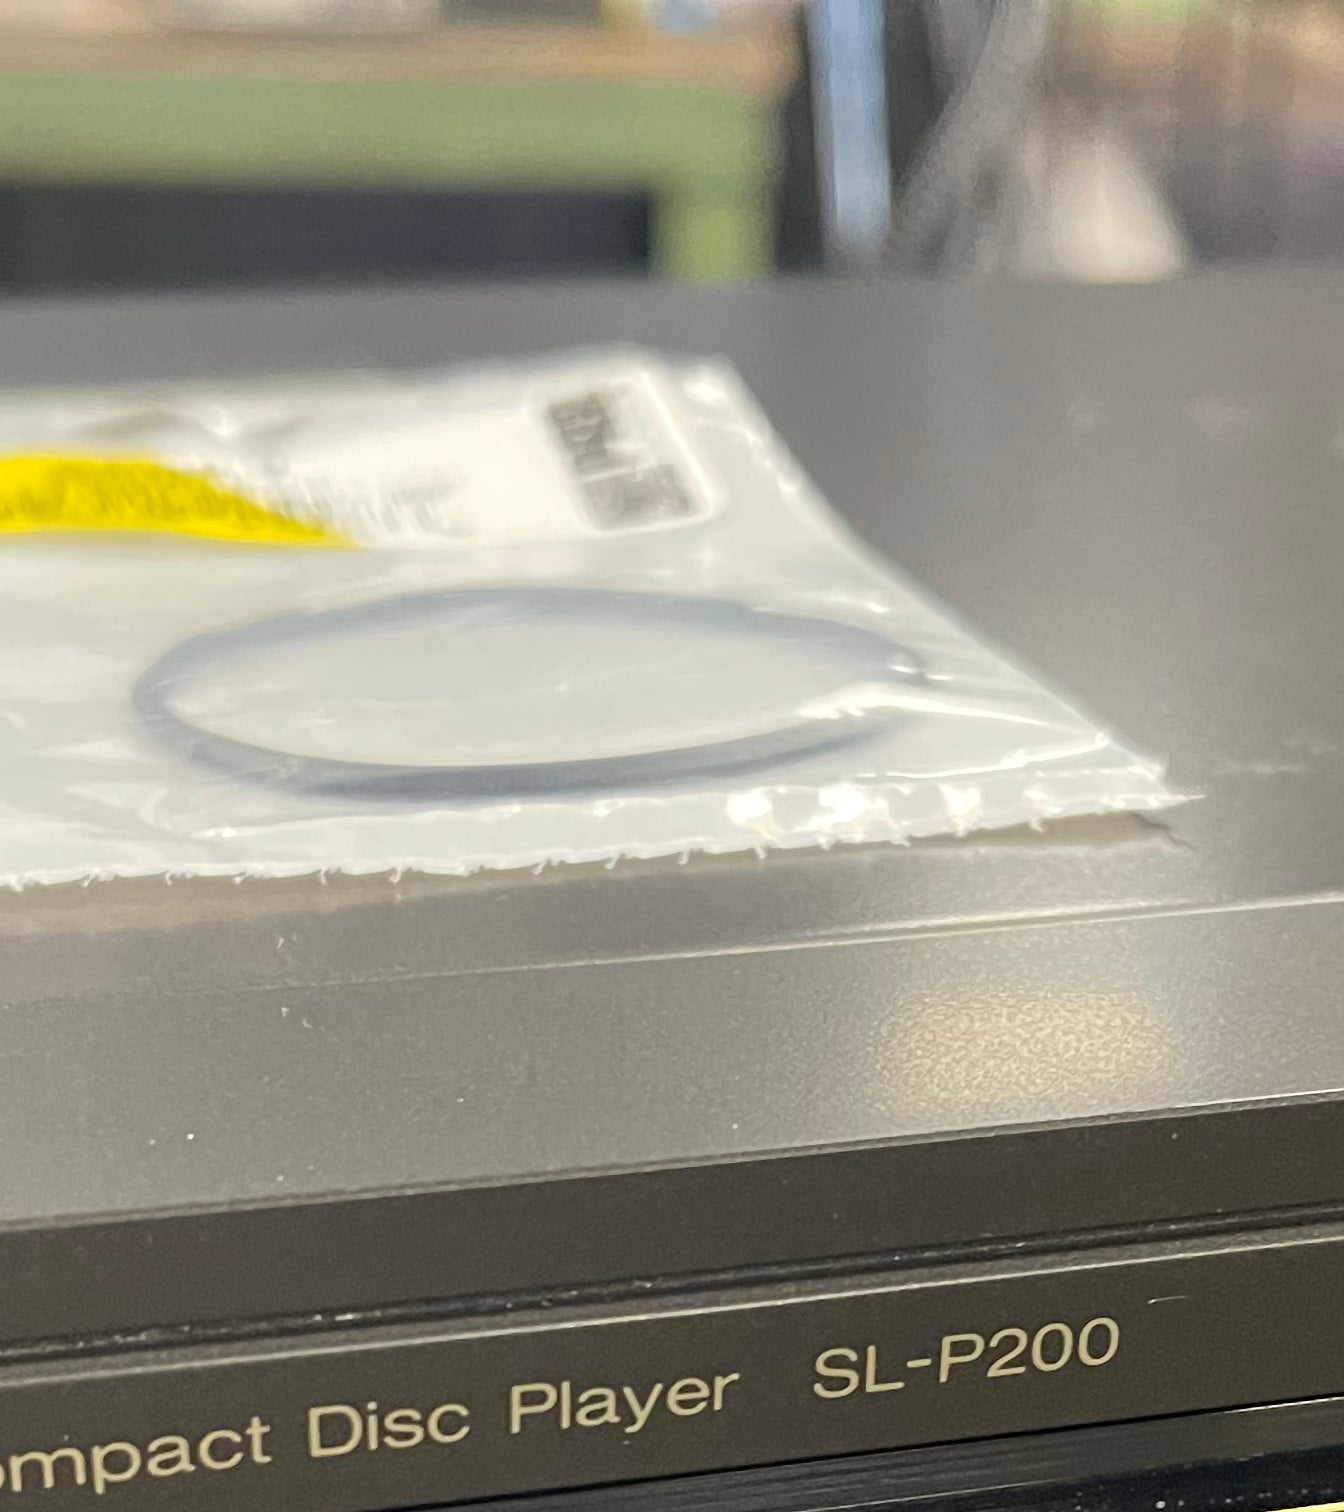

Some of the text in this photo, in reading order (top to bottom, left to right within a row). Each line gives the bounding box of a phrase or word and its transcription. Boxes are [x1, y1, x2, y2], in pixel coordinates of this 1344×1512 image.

[307, 1401, 470, 1458] Disc
[509, 1371, 740, 1434] Player
[812, 1317, 1121, 1399] SL-P200
